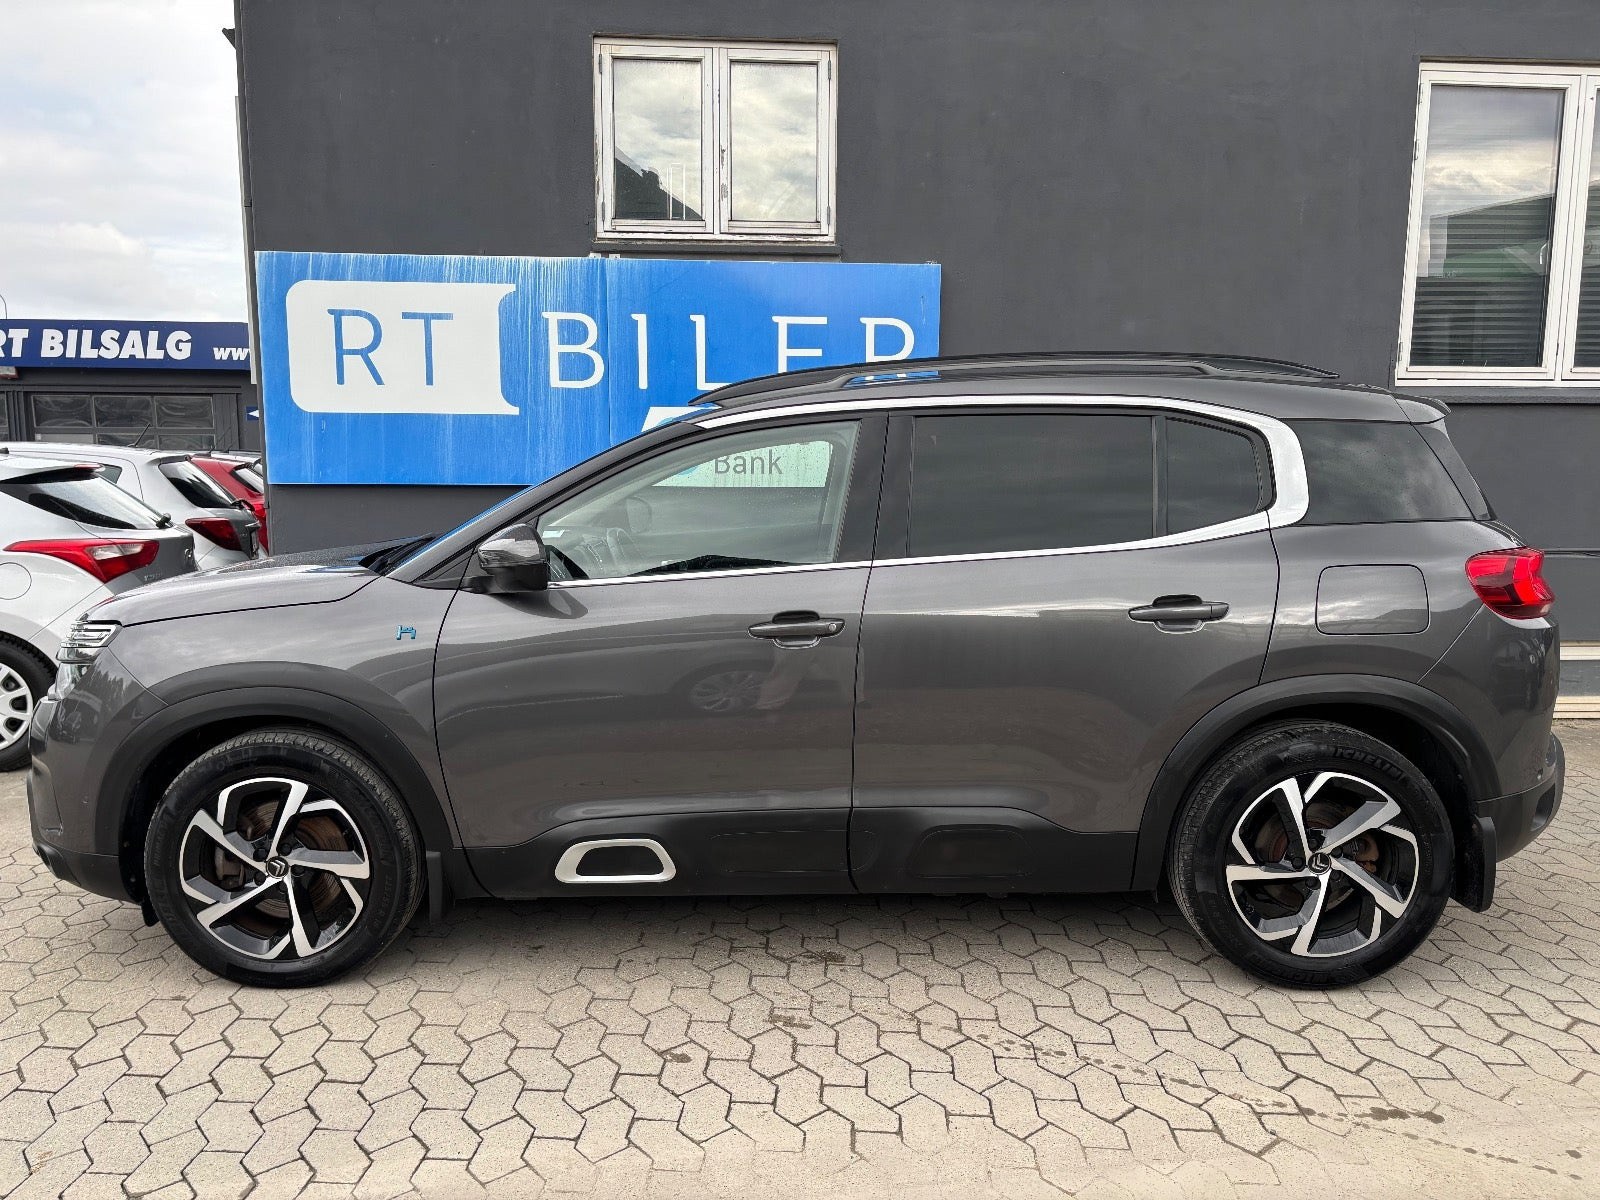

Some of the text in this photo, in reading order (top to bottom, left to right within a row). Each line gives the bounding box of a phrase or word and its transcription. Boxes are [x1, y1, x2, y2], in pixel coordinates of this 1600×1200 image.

[41, 329, 192, 360] BILSALG
[213, 347, 250, 360] ww
[326, 308, 915, 391] RT BILER
[714, 449, 783, 475] Bank
